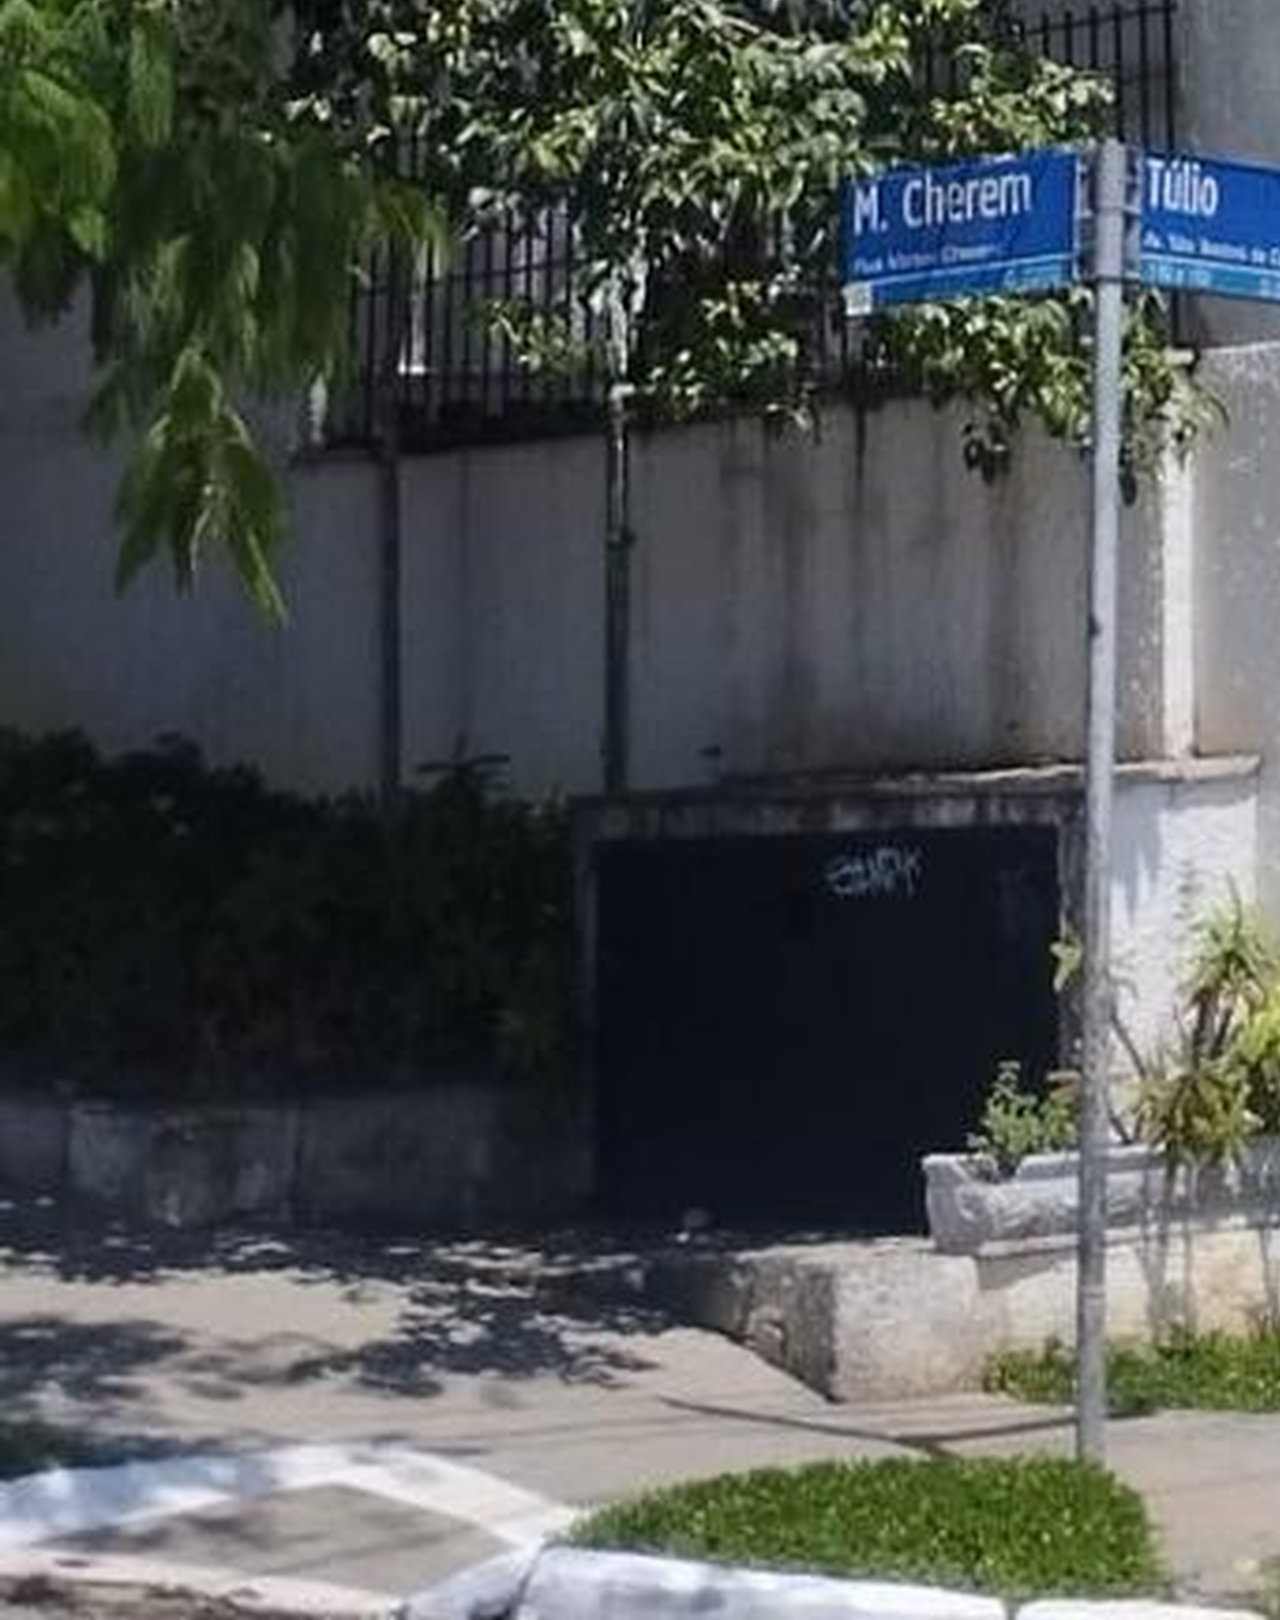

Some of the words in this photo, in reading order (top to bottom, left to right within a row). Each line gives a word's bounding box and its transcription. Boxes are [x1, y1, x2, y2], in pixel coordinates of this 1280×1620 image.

[853, 182, 888, 236] M.
[902, 169, 1031, 228] Cherem
[1147, 158, 1219, 217] Túlio
